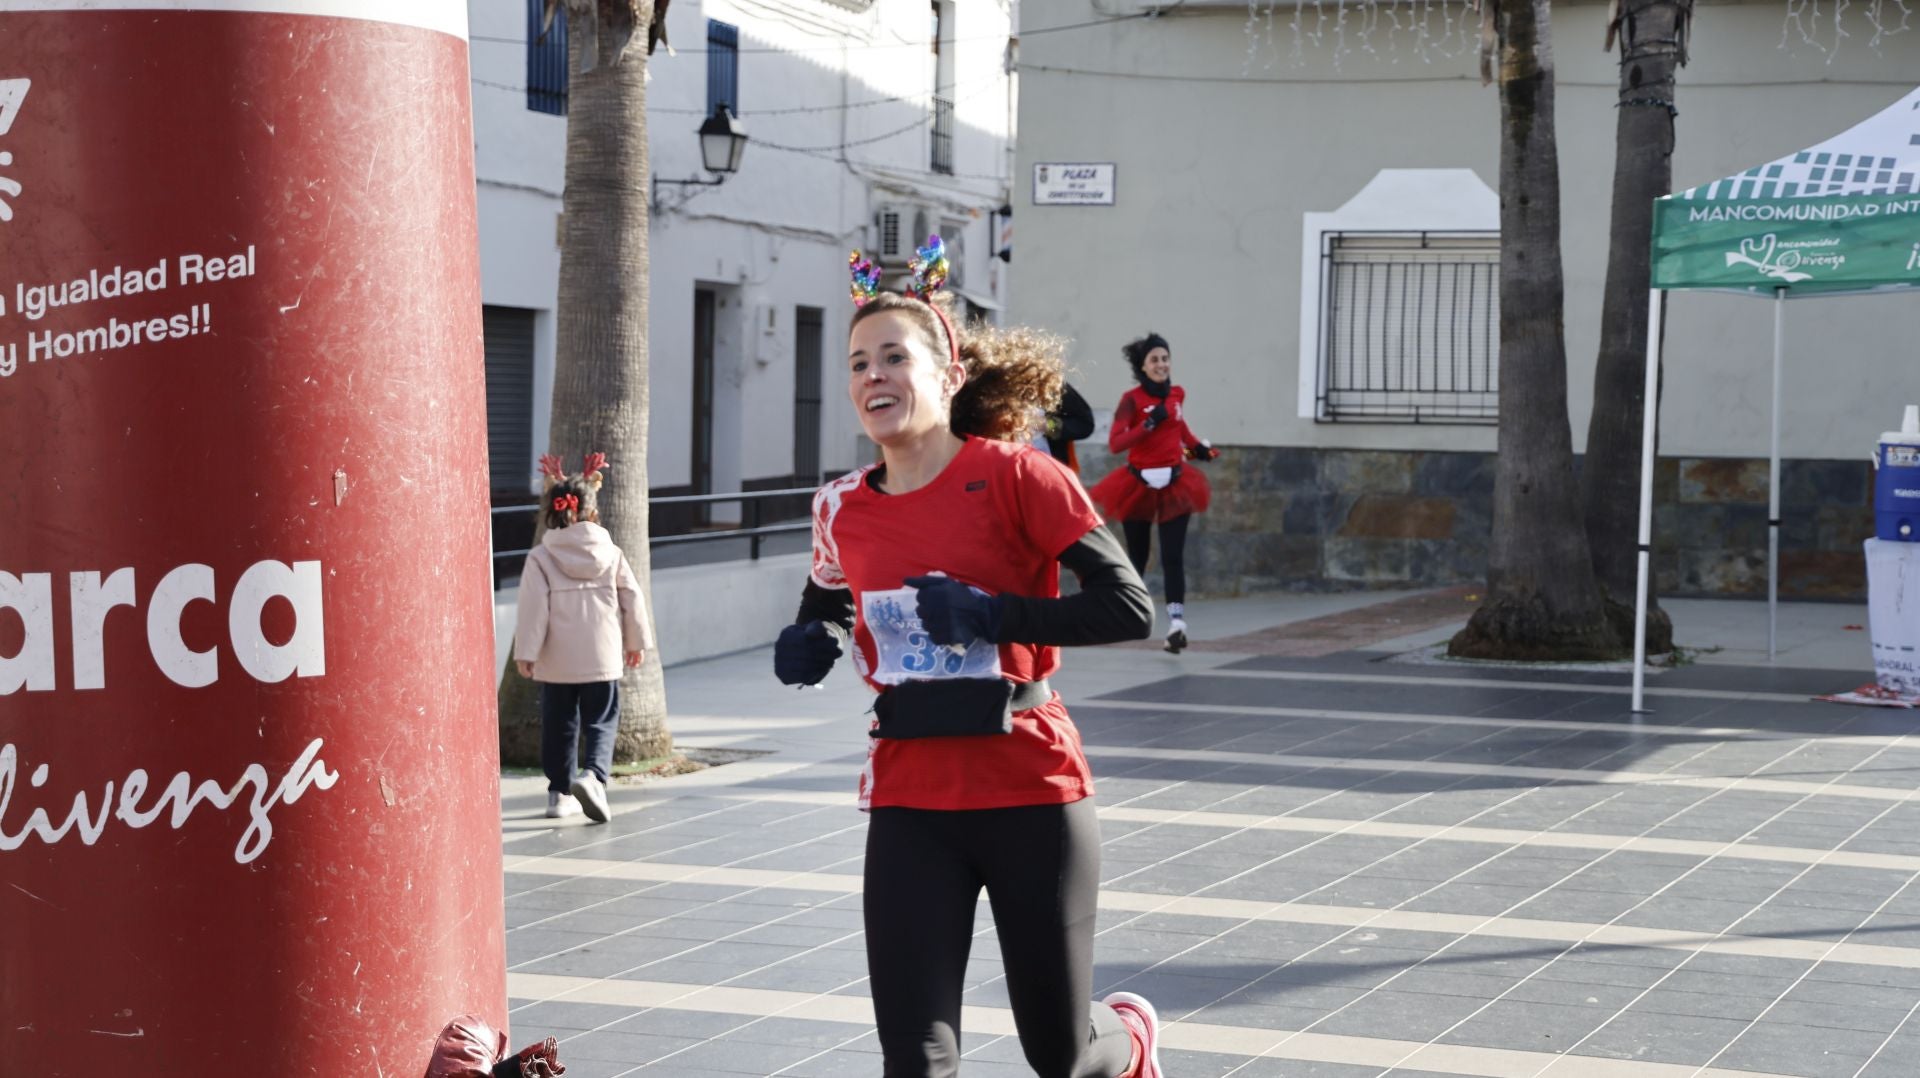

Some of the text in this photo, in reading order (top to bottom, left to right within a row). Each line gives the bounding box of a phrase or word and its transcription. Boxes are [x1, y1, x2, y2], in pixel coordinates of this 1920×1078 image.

[1062, 169, 1097, 179] PLAZA
[1689, 199, 1920, 222] MANCOMUNIDAD INT
[16, 258, 167, 320] Igualdad
[179, 245, 256, 286] Real
[0, 343, 17, 377] y
[28, 303, 211, 362] Hombres!!
[0, 559, 326, 695] arca
[0, 738, 340, 864] livenza
